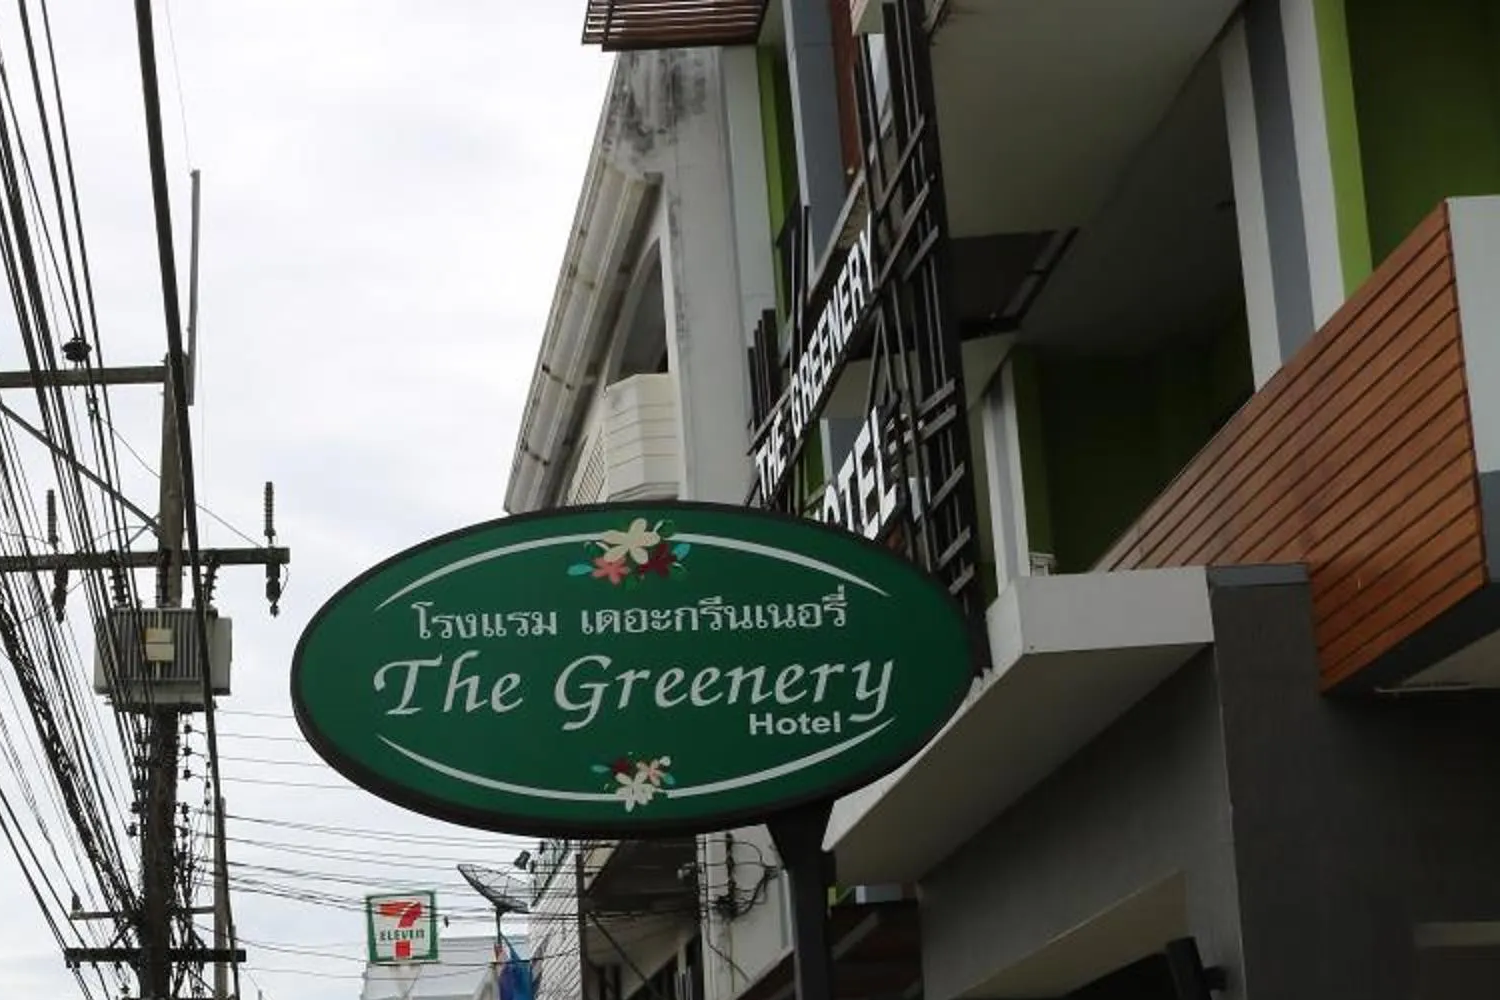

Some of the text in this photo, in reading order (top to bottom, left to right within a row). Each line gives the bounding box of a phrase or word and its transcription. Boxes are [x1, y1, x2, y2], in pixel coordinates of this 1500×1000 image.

[755, 211, 875, 502] THE GREENERY
[814, 405, 897, 540] OTEL
[411, 584, 848, 639] โรงแรม เดอะกรีนเนอรี่
[373, 650, 894, 731] The Greenery
[749, 710, 842, 736] Hotel
